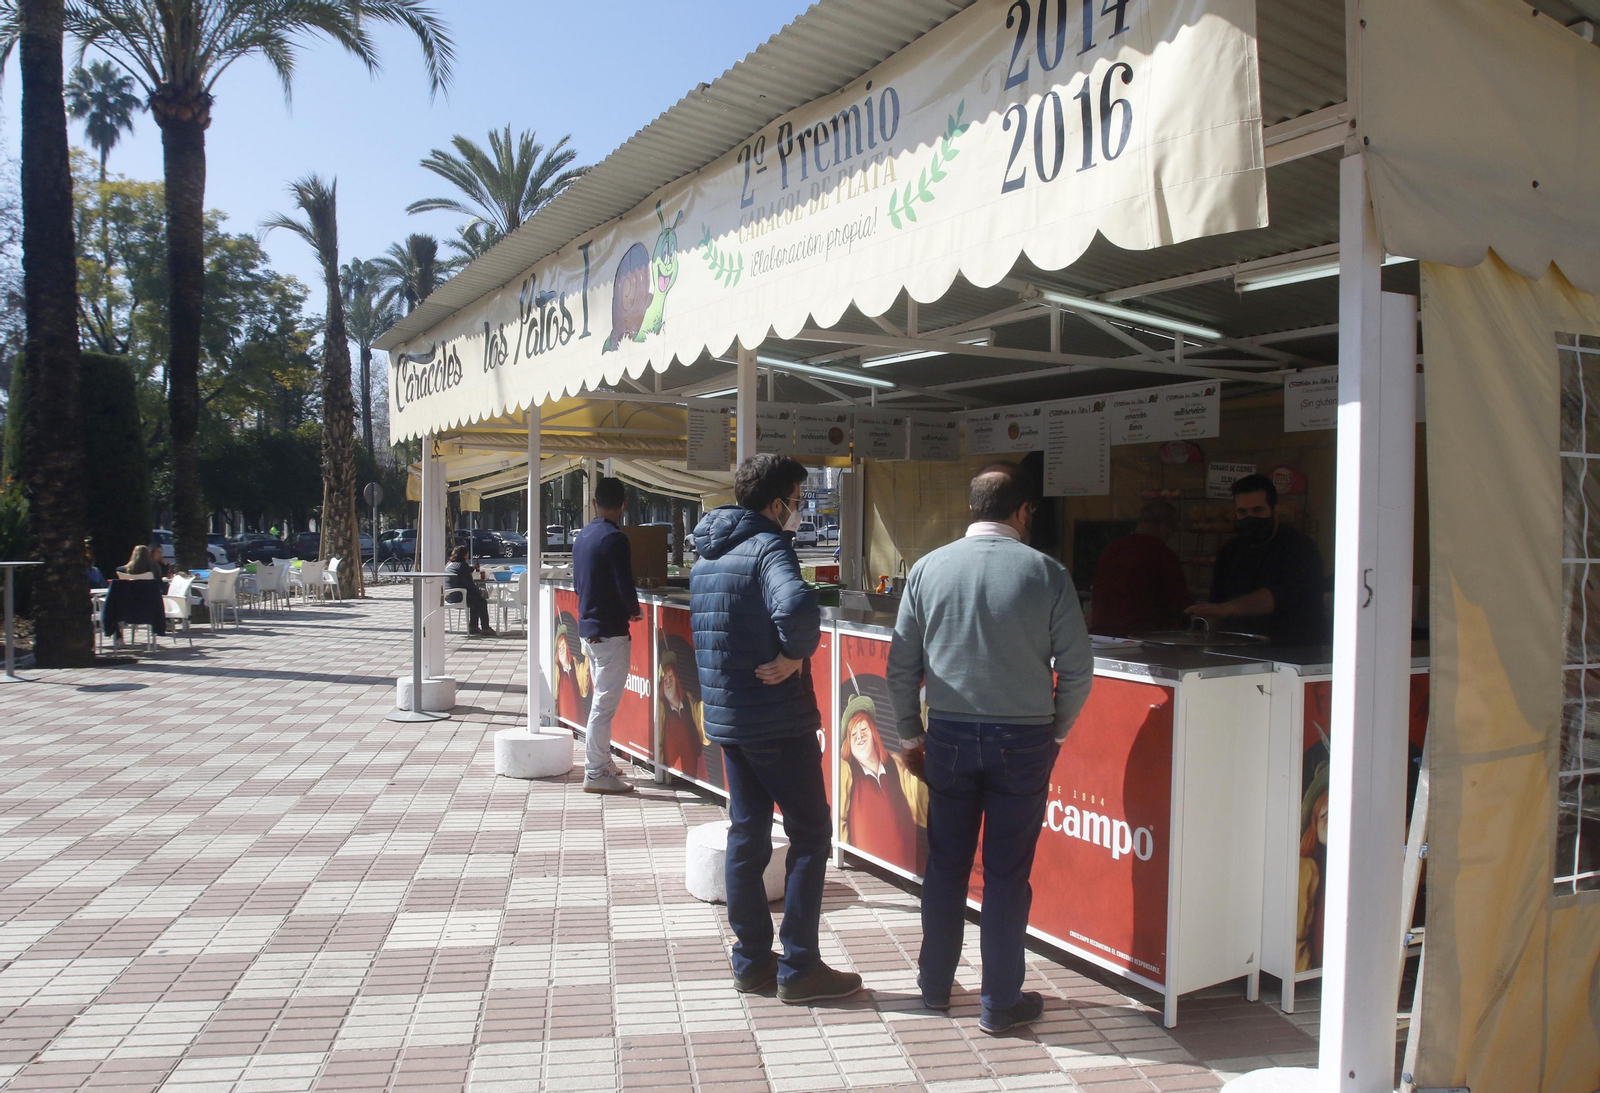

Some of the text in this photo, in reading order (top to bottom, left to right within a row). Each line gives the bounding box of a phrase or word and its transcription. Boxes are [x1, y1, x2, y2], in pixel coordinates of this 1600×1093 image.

[777, 80, 900, 190] Premio
[1001, 62, 1134, 194] 2016
[738, 147, 898, 245] CARACOL DE PLATA
[826, 206, 878, 262] propia!
[396, 341, 463, 413] Caracoles
[484, 321, 508, 373] los
[514, 273, 575, 365] Patos
[1042, 799, 1154, 861] campo
[1073, 790, 1105, 806] 1904
